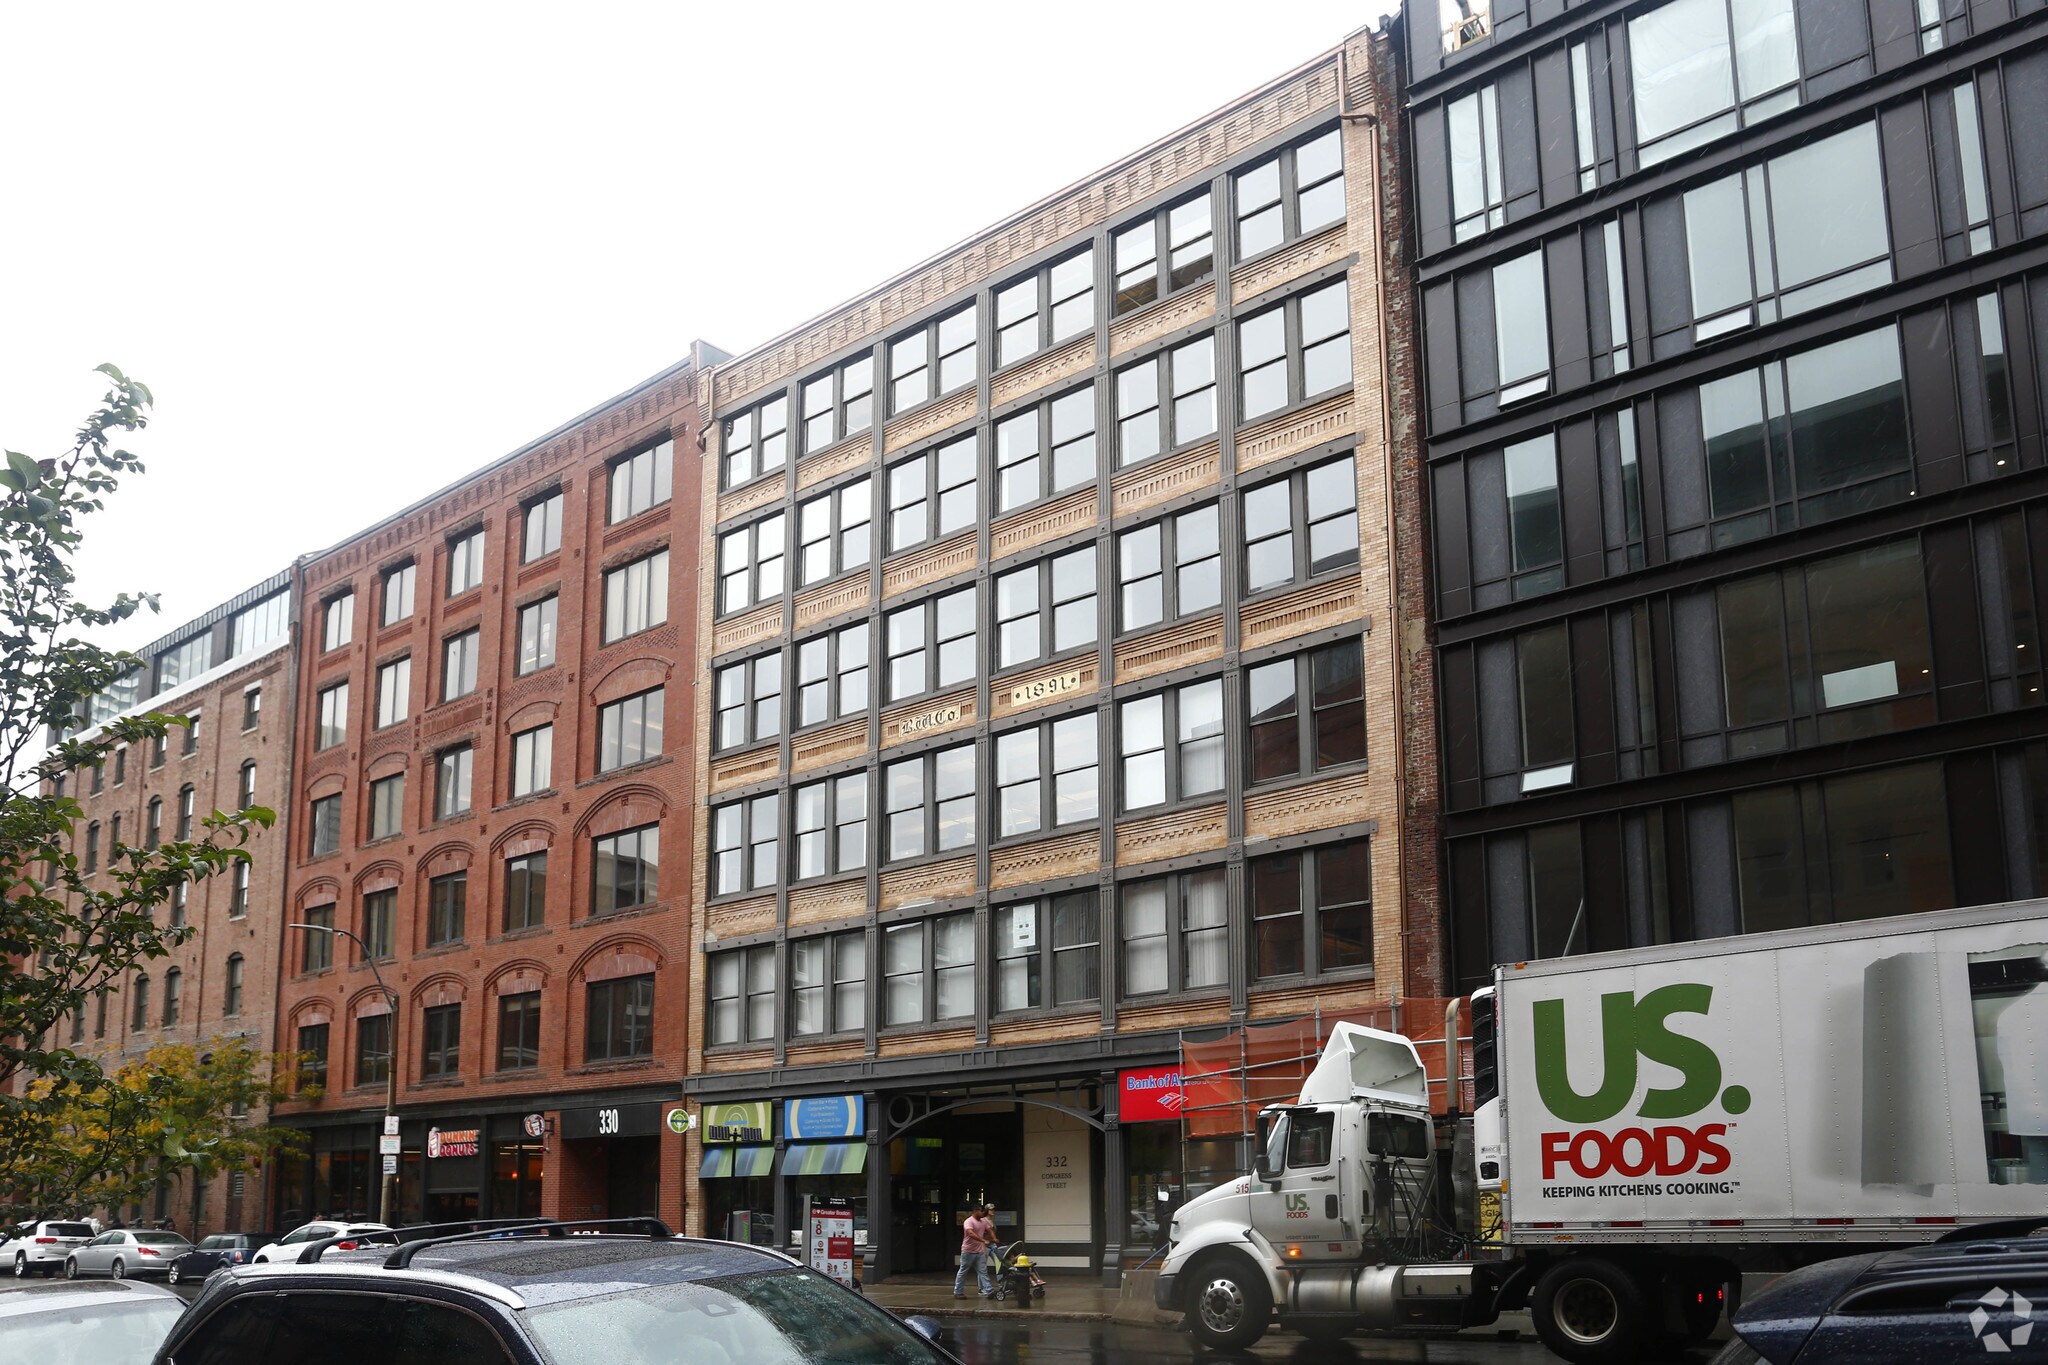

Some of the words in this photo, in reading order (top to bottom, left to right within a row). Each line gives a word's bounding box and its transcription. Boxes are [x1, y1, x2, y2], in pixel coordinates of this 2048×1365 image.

[1127, 1075, 1157, 1090] Bank
[1158, 1073, 1171, 1088] of
[599, 1108, 619, 1135] 330
[439, 1144, 478, 1157] DONUTS
[1541, 1123, 1731, 1180] FOODS
[1045, 1156, 1067, 1168] 332
[1041, 1172, 1072, 1180] CONGRESS
[1235, 1184, 1249, 1194] 515
[1542, 1185, 1596, 1198] KEEPING
[1599, 1183, 1662, 1197] KITCHENS
[1286, 1211, 1309, 1219] FOODS
